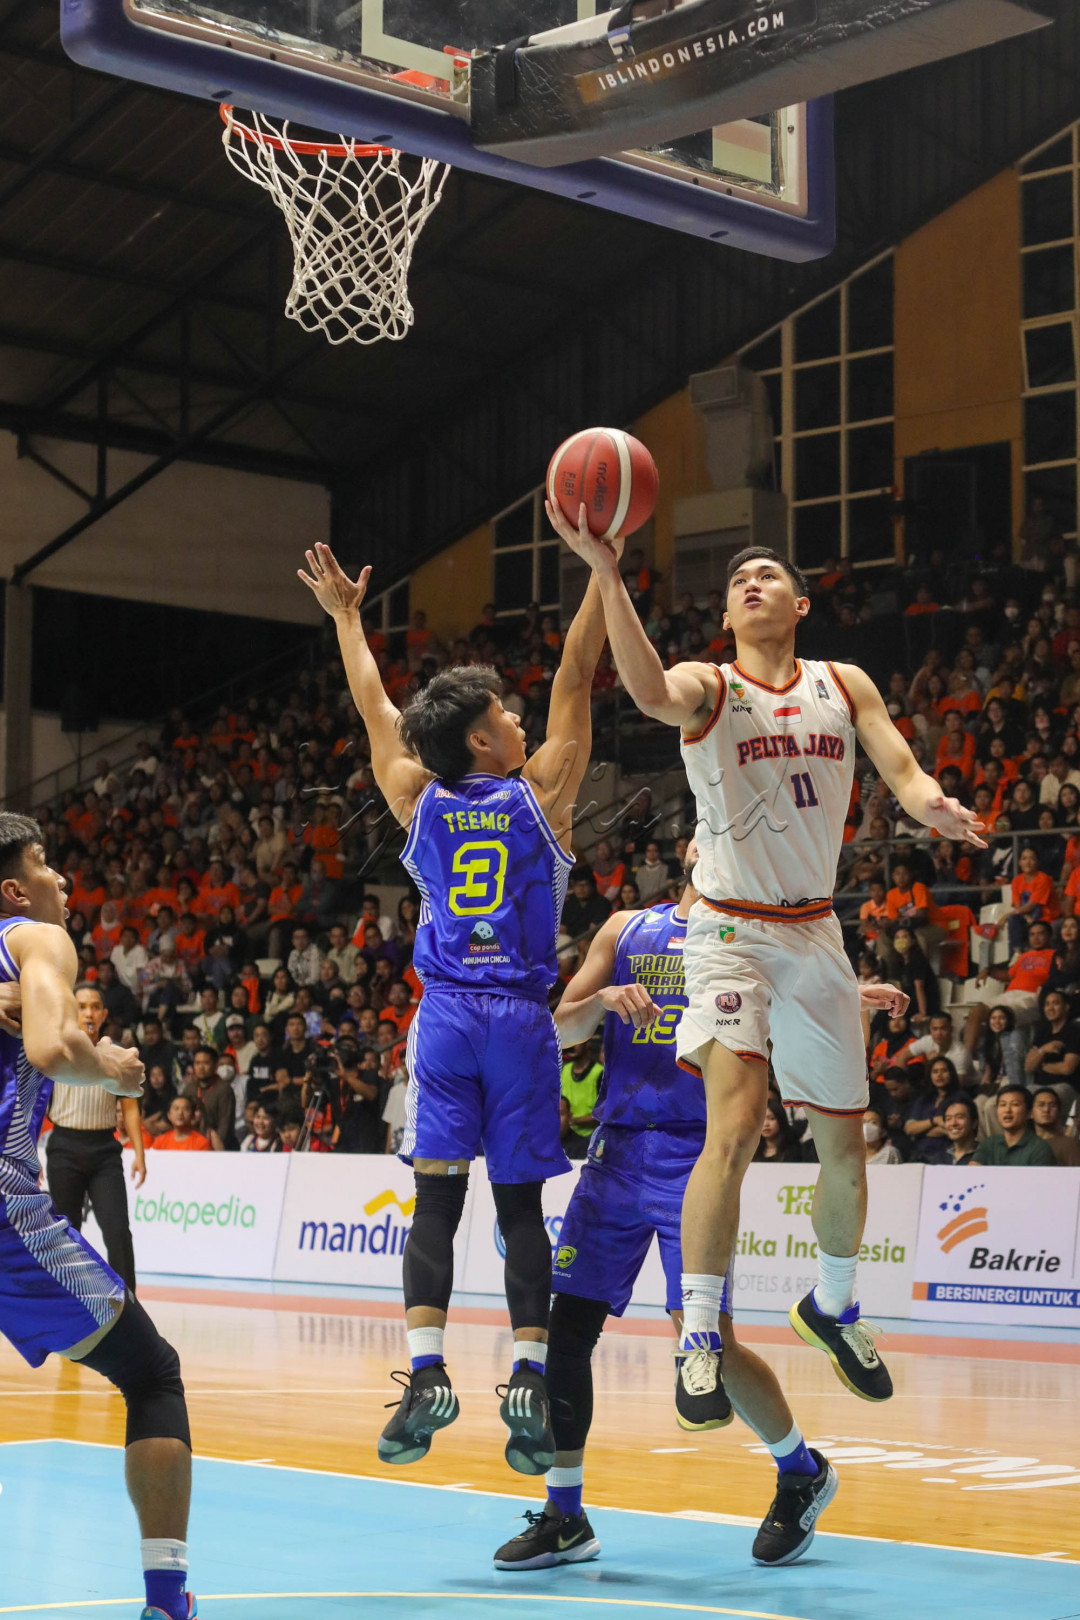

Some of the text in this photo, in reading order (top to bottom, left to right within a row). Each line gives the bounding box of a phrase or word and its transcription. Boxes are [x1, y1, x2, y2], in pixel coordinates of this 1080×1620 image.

[597, 11, 786, 91] IBLINDONESIA.COM
[594, 461, 607, 513] molten
[736, 733, 845, 767] PELITA JAYA
[790, 771, 819, 809] 11
[443, 811, 510, 834] TEEMO
[448, 840, 509, 917] 3
[481, 944, 500, 952] panda
[715, 1018, 742, 1026] NKR
[134, 1191, 256, 1233] tokopedia
[299, 1214, 411, 1256] mandir
[786, 1234, 906, 1264] Inesia
[969, 1247, 1061, 1273] Bakrie
[935, 1286, 1021, 1304] BERSINERGI
[1022, 1289, 1074, 1306] UNTUK
